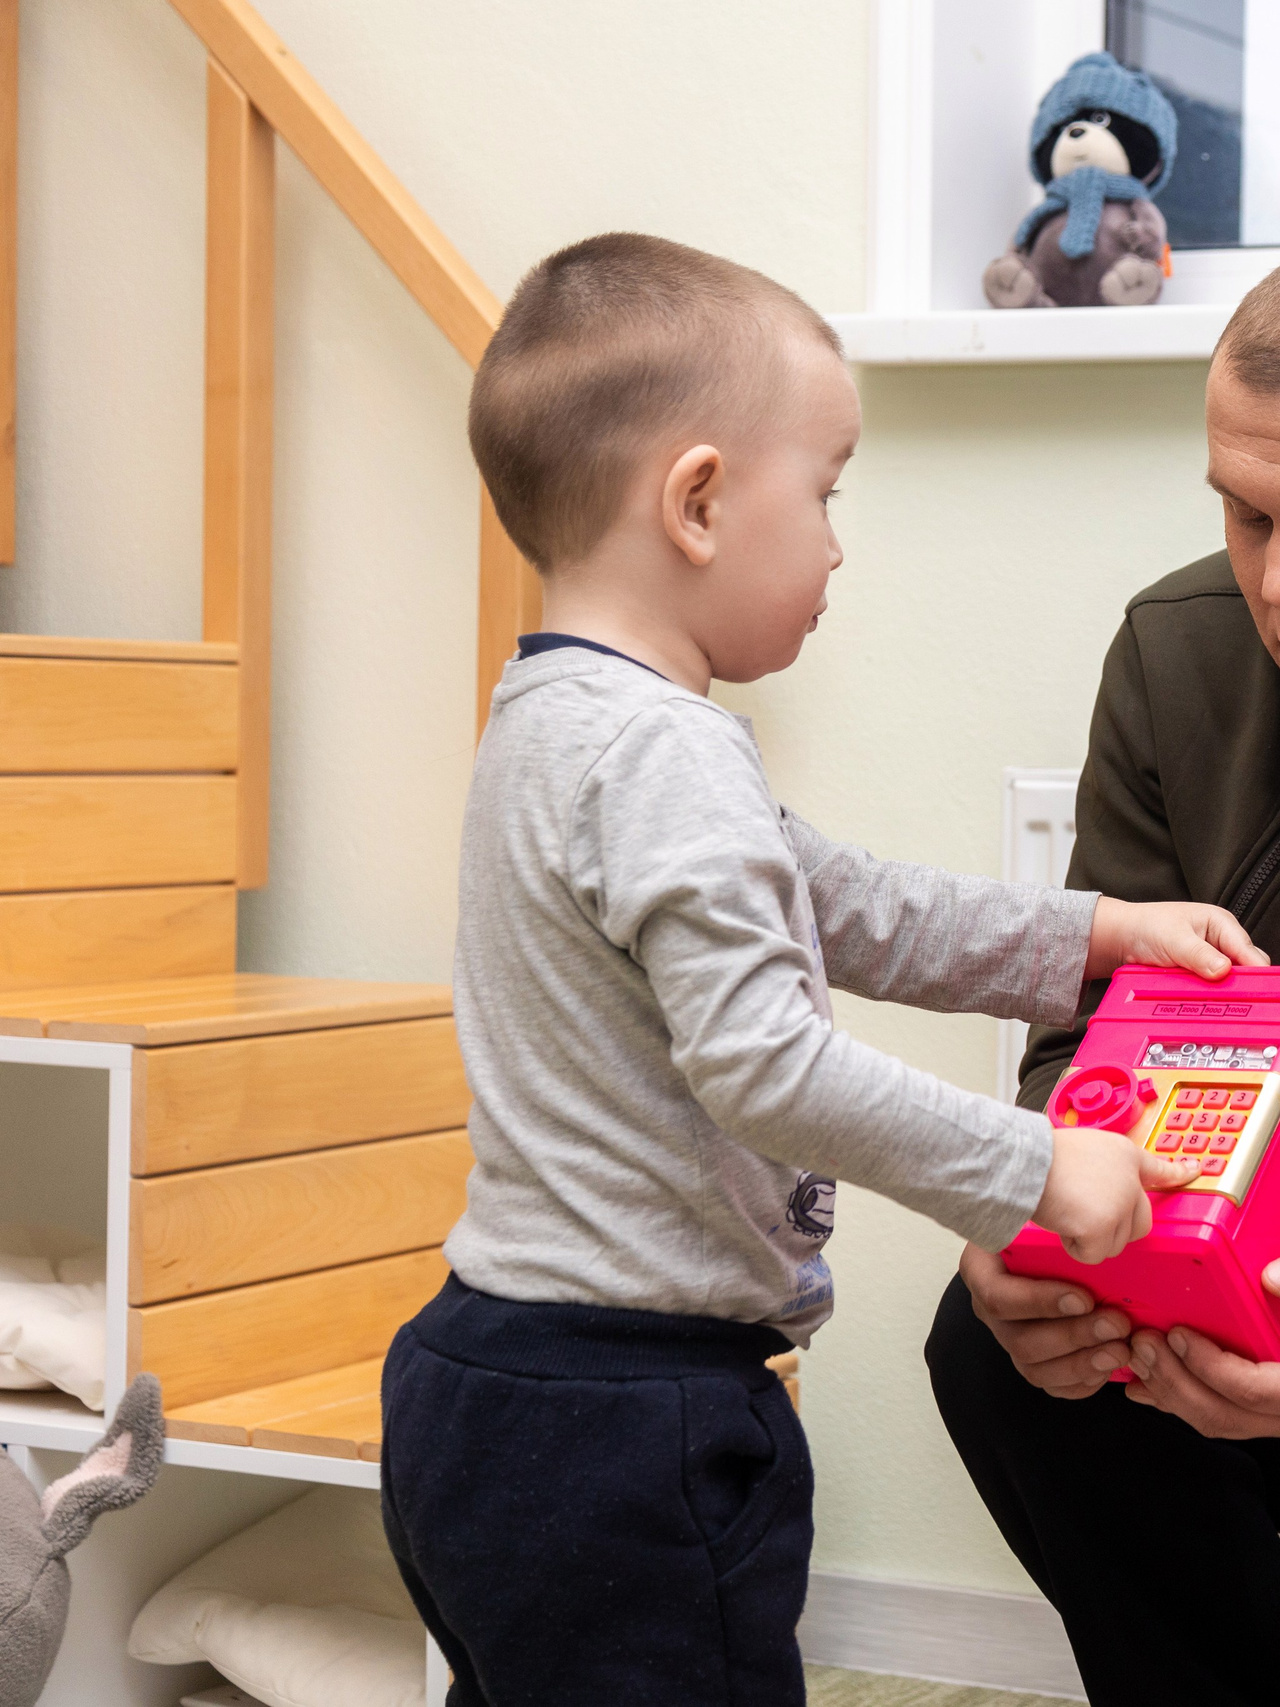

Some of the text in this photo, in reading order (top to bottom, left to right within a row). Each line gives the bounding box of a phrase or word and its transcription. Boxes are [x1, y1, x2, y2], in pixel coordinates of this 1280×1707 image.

[1210, 1091, 1218, 1100] 2
[1237, 1092, 1246, 1102] 3
[1173, 1113, 1235, 1125] 4 5 6
[1162, 1134, 1225, 1146] 7 8 9
[1205, 1158, 1218, 1168] #
